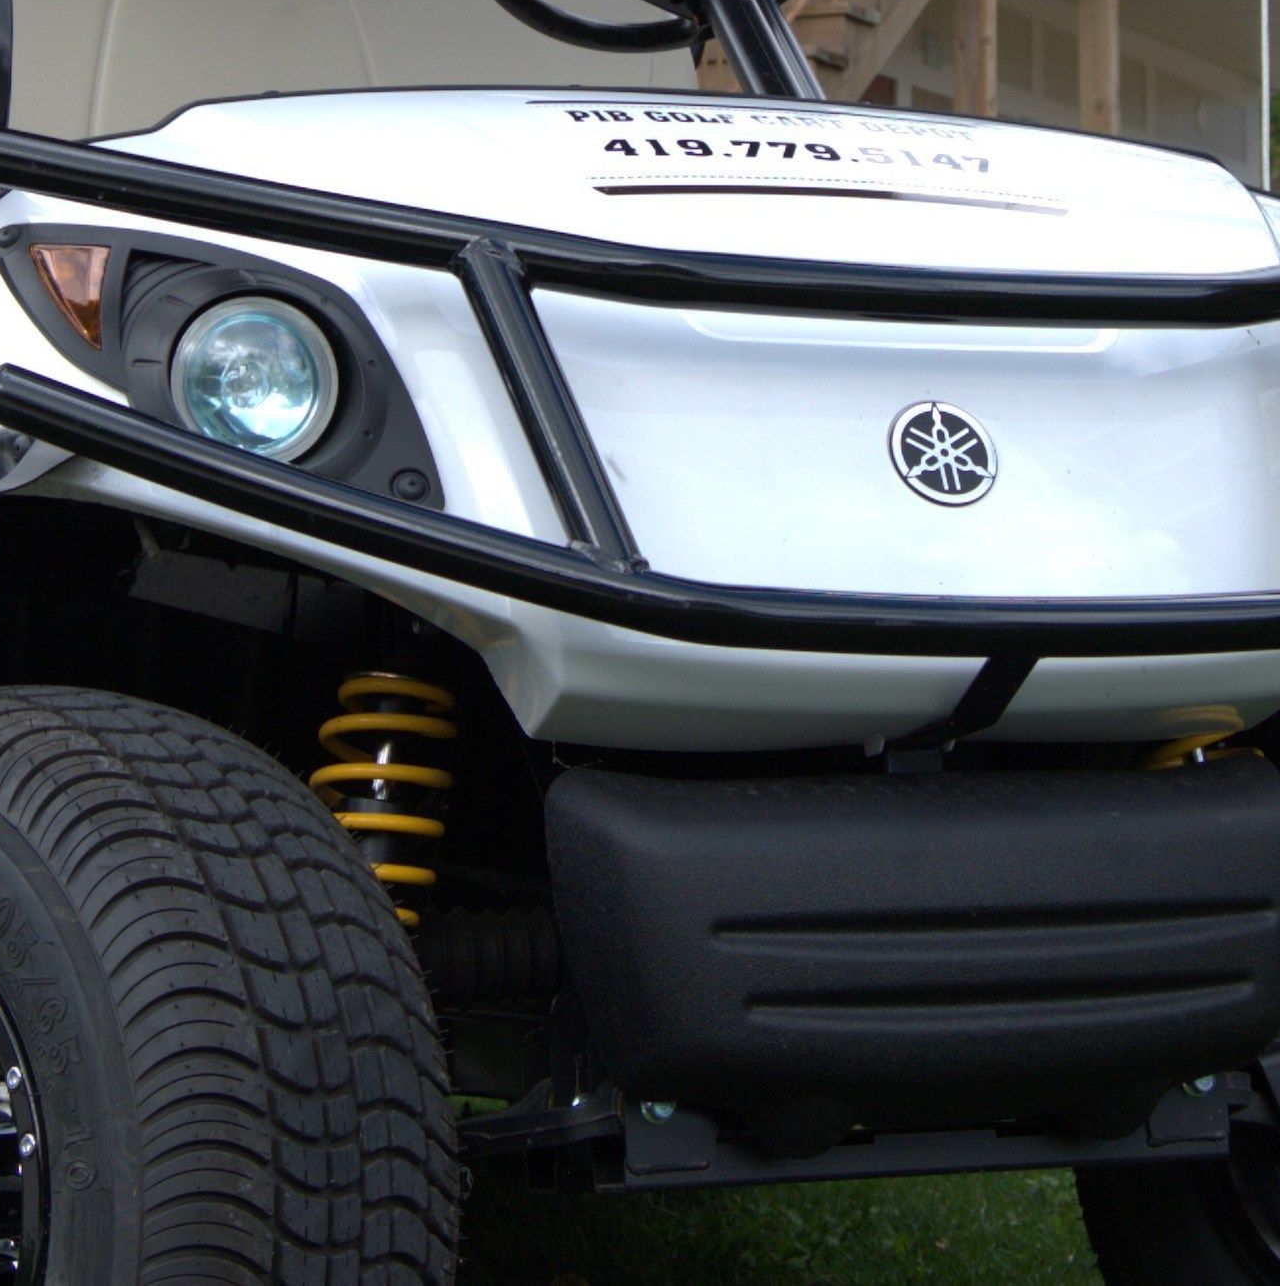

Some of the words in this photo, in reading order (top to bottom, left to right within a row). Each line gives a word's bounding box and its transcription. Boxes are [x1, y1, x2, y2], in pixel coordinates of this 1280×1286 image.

[564, 109, 634, 123] PIB
[643, 110, 735, 125] GOLF
[602, 138, 990, 174] 419.779.5147
